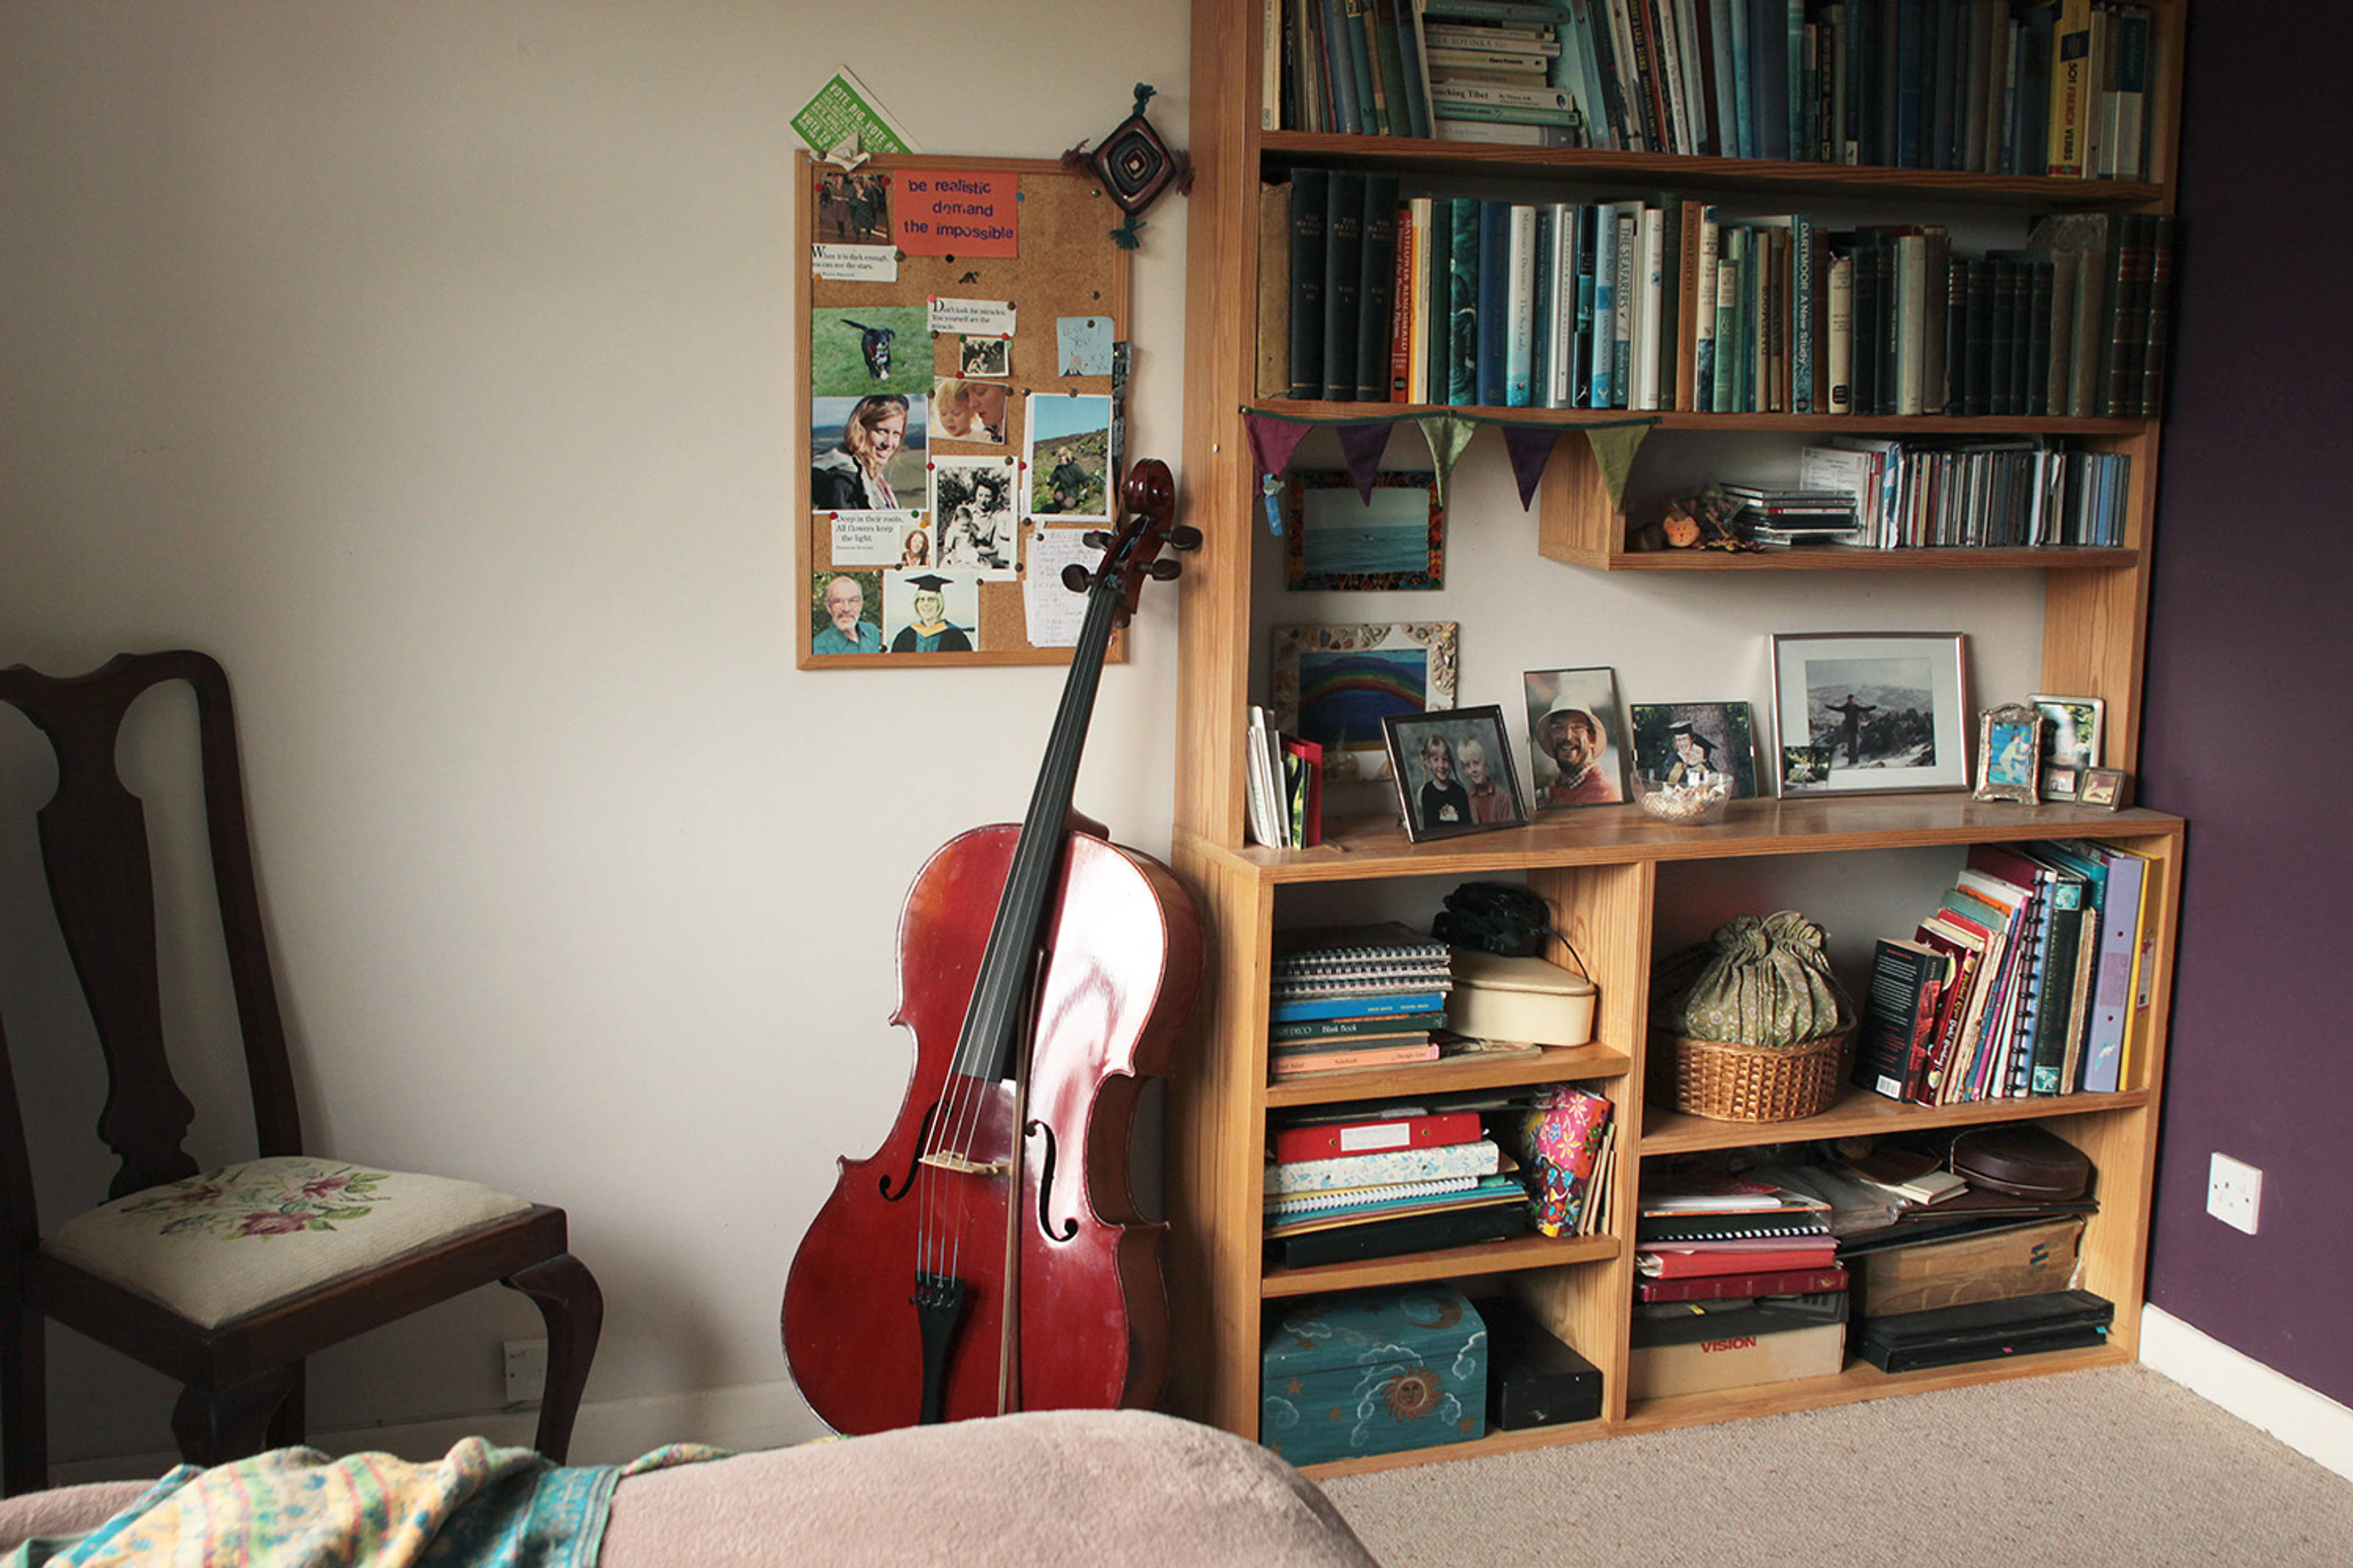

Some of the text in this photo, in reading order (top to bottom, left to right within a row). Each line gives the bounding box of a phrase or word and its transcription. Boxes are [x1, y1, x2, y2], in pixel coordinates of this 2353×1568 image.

[2067, 62, 2078, 83] 501
[1468, 90, 1489, 99] Tibet
[830, 83, 851, 107] VOTE
[865, 120, 888, 144] VOTE
[2066, 87, 2076, 125] FRENCH
[801, 112, 832, 145] VOTE TO
[2063, 128, 2075, 161] VERBS
[909, 179, 991, 195] be realistic
[933, 201, 993, 216] demand
[904, 220, 1014, 241] the impossible
[1618, 227, 1631, 309] THE SEAFARERS
[1401, 219, 1412, 351] MAYFLOWER REMEMBERED
[1797, 222, 1809, 365] DARTMOOR A New Study
[876, 525, 894, 533] keep
[1340, 1023, 1357, 1032] Book
[1700, 1335, 1757, 1353] VISION
